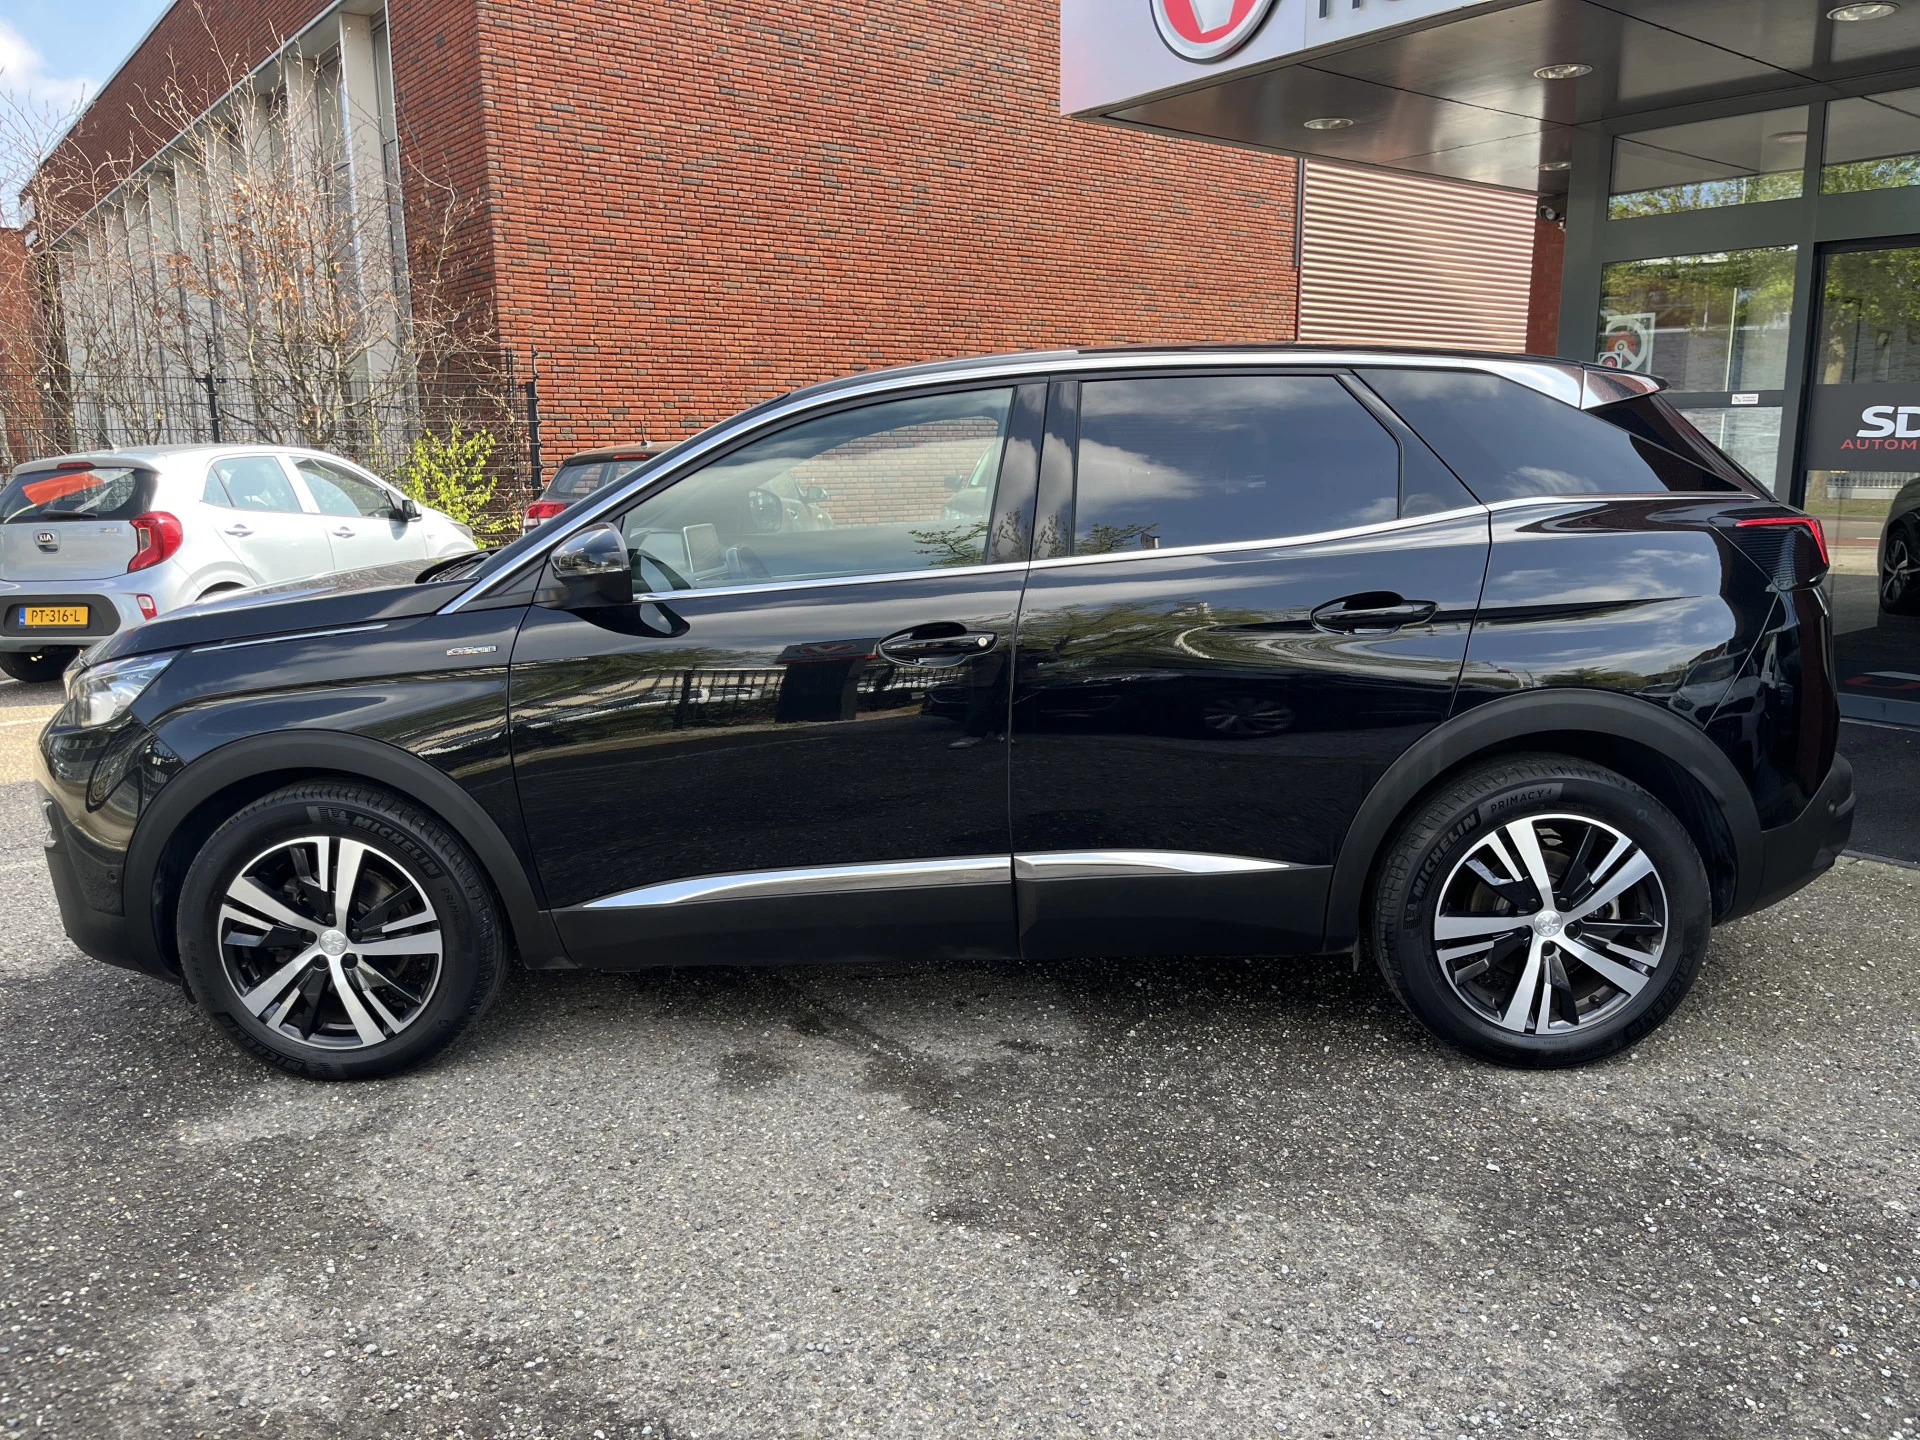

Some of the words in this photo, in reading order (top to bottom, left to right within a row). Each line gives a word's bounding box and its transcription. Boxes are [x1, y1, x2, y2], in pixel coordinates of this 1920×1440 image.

[38, 533, 54, 542] KIA
[31, 609, 81, 623] PT-316-L
[352, 815, 440, 878] MICHELIN
[1412, 813, 1479, 898] MICHELIN
[1490, 789, 1545, 813] PRIMACY
[1547, 788, 1552, 796] 4
